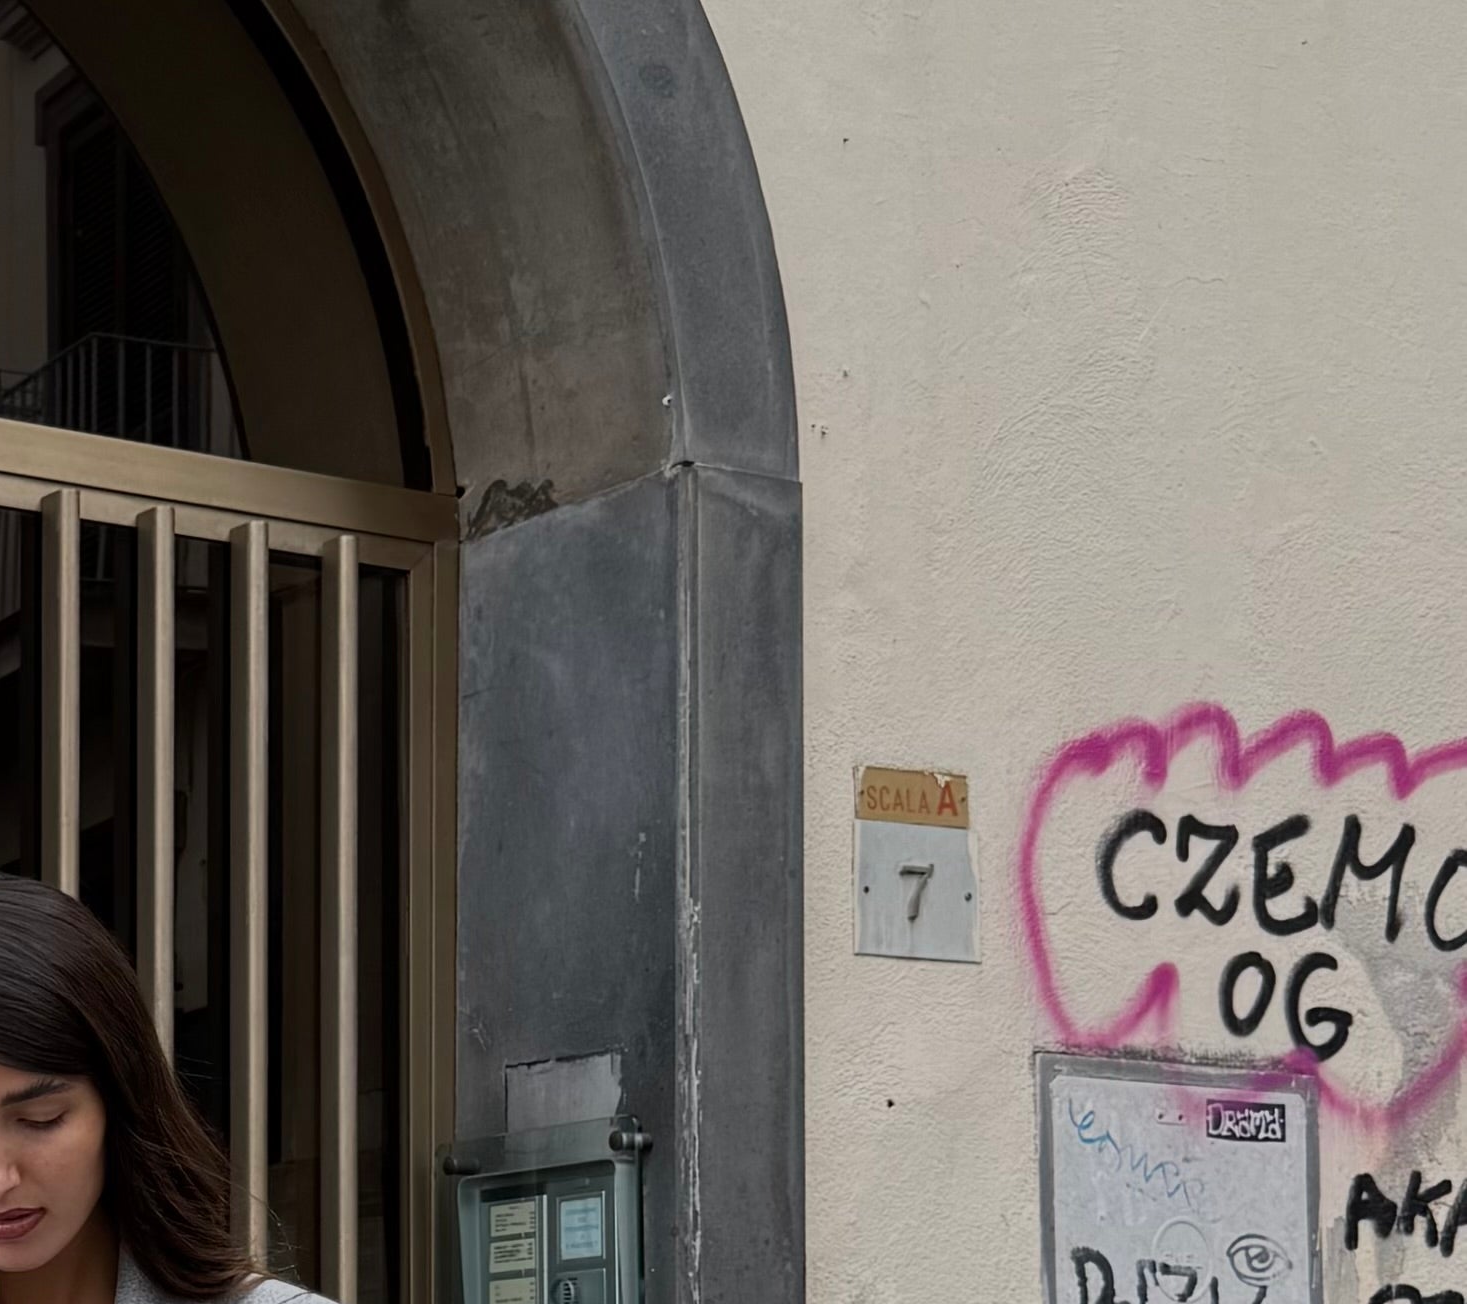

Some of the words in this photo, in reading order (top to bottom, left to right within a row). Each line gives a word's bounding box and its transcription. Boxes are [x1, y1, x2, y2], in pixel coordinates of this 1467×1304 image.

[865, 784, 931, 816] SCALA
[936, 781, 969, 818] A
[900, 863, 934, 921] 7
[1219, 951, 1353, 1063] OG
